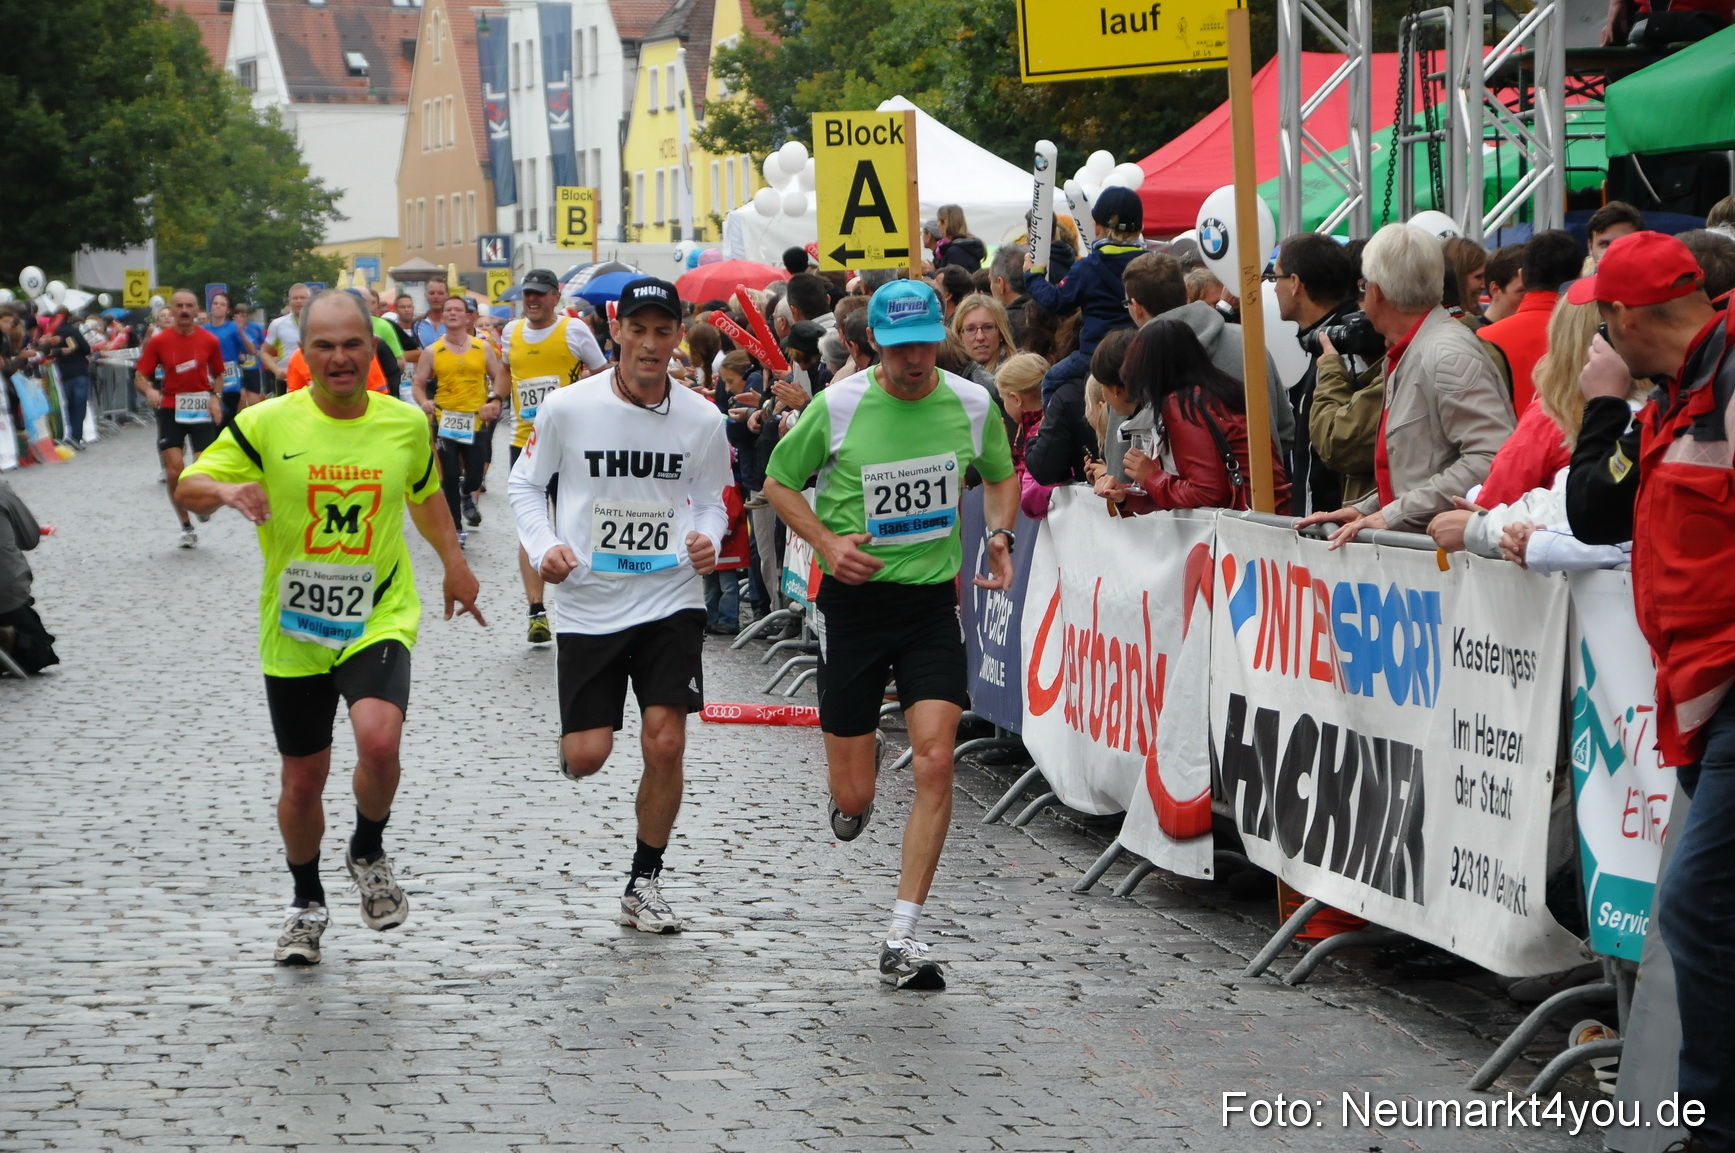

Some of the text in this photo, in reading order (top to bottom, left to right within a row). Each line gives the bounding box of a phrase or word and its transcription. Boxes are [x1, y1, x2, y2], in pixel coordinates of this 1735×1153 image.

[1100, 3, 1161, 35] lauf
[825, 118, 904, 146] Block
[561, 189, 593, 201] Block
[839, 160, 898, 235] A
[567, 206, 587, 235] B
[129, 279, 142, 298] C
[493, 280, 506, 298] C
[633, 285, 668, 299] THULE
[745, 340, 767, 359] BKK
[180, 398, 207, 410] 2288
[443, 417, 470, 430] 2254
[308, 464, 383, 480] Müller
[584, 450, 683, 479] THULE
[864, 465, 942, 482] PARTL Neumarkt
[874, 475, 947, 515] 2831
[323, 504, 362, 533] M
[594, 507, 665, 518] PARTL Neumarkt
[600, 520, 670, 551] 2426
[313, 571, 358, 581] Neumarkt
[617, 558, 652, 571] Marco
[288, 580, 364, 617] 2952
[297, 616, 352, 639] Wolfgang
[1453, 708, 1524, 765] Im Herzen
[1455, 765, 1514, 821] der Stadt
[1450, 846, 1490, 897] 92318
